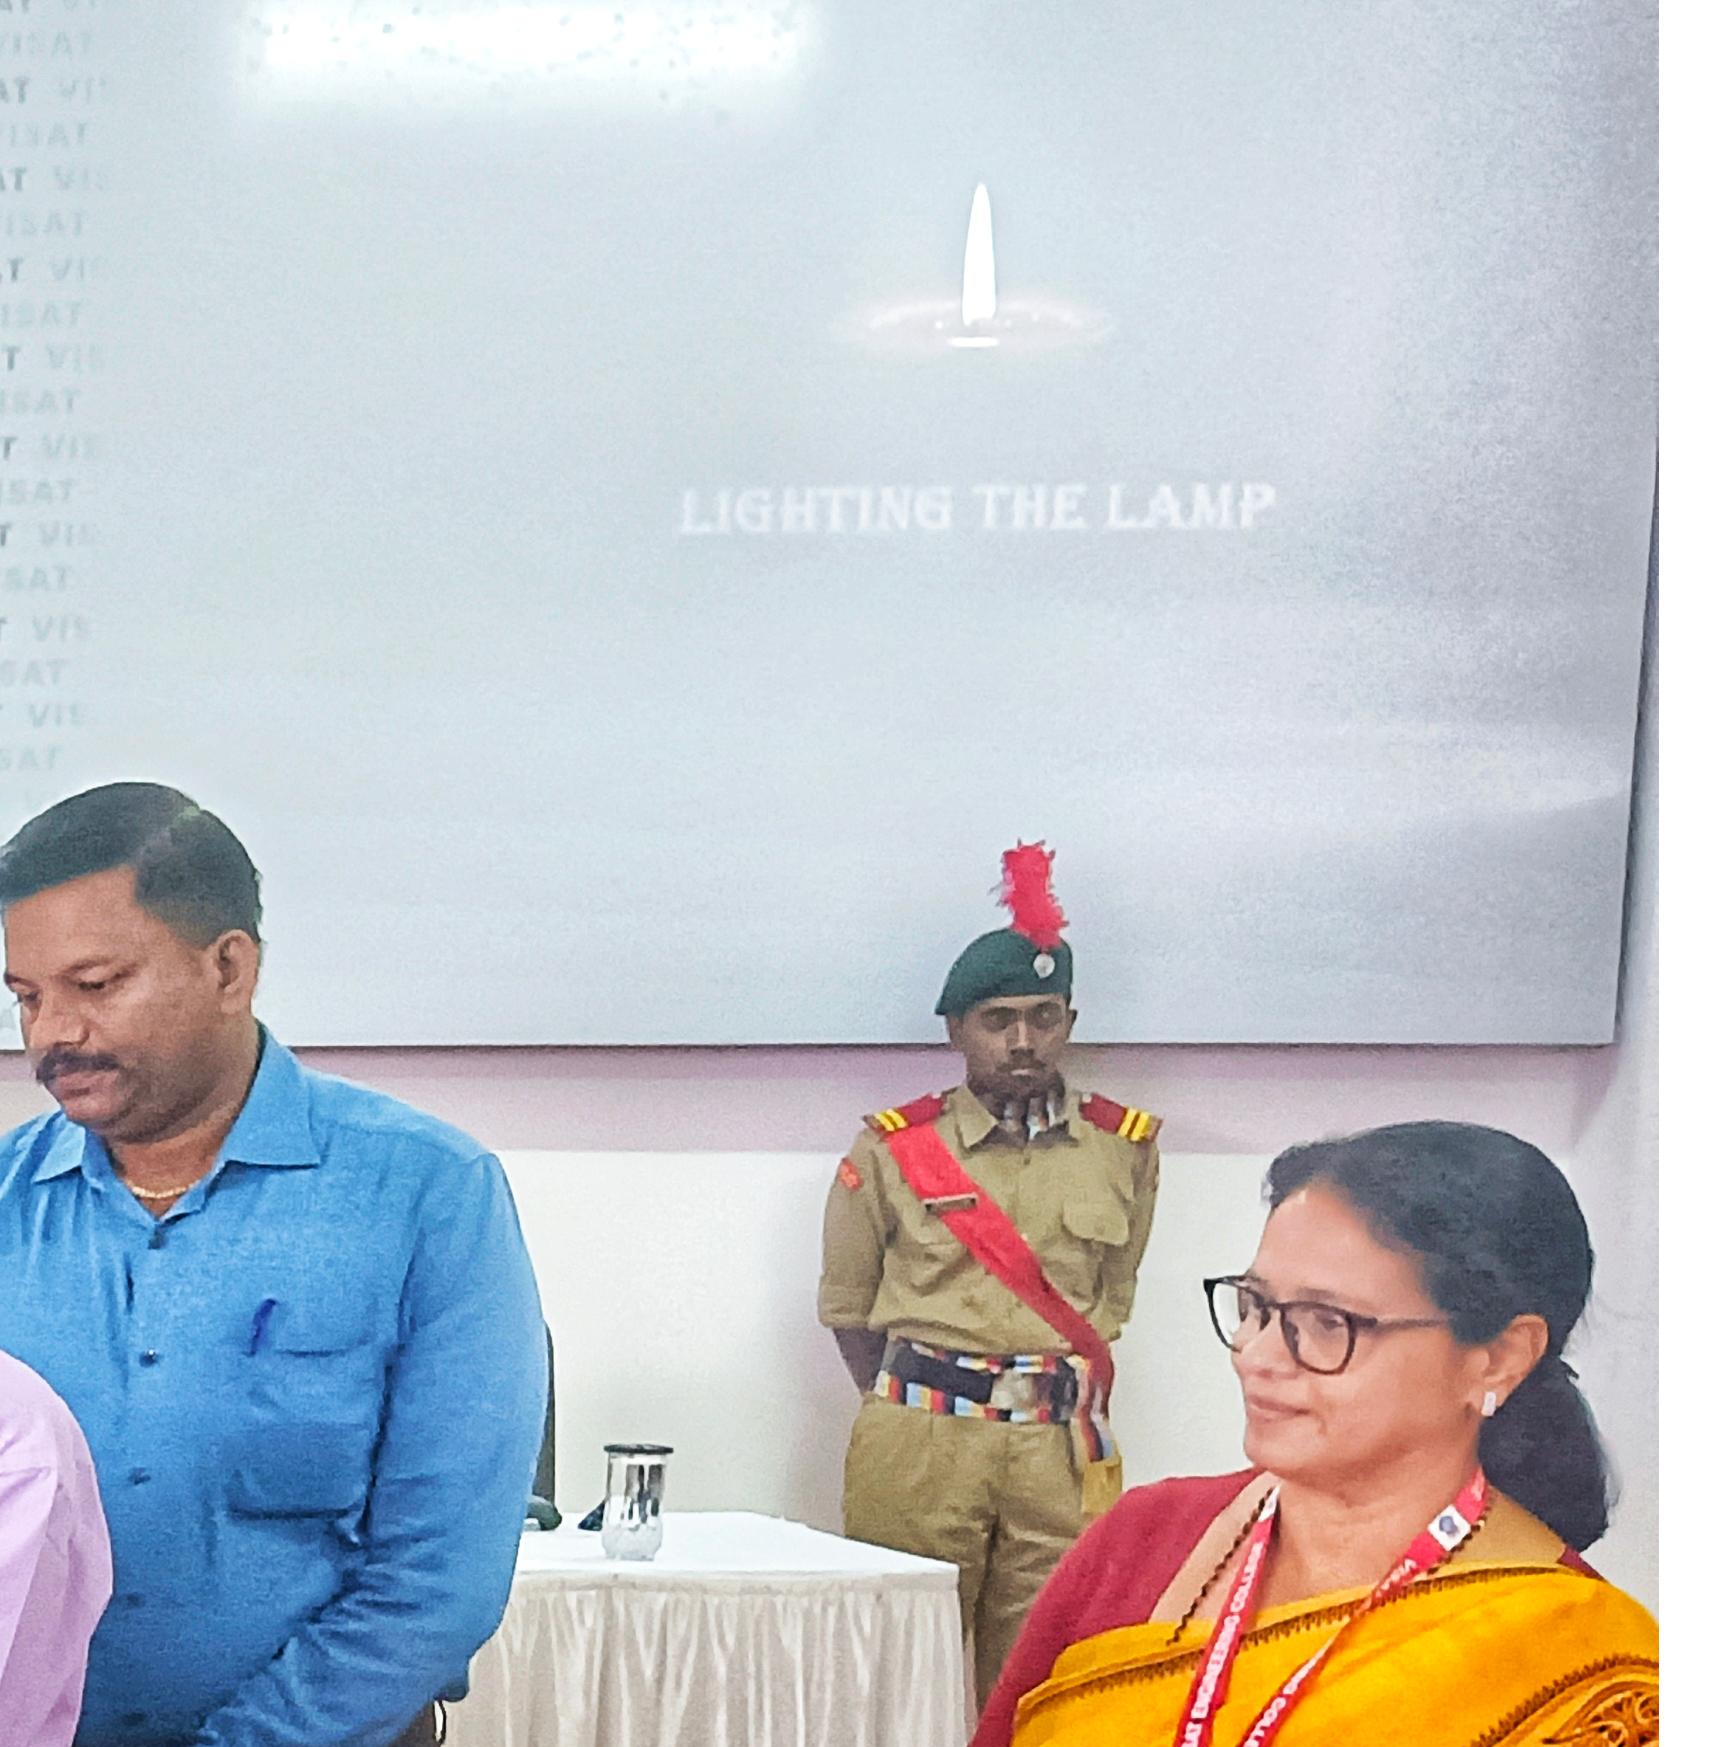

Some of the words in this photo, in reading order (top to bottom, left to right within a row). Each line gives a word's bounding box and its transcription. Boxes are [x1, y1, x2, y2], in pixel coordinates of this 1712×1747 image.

[680, 485, 954, 535] LIGHTING
[973, 482, 1088, 531] THE
[1102, 482, 1275, 530] LAMP
